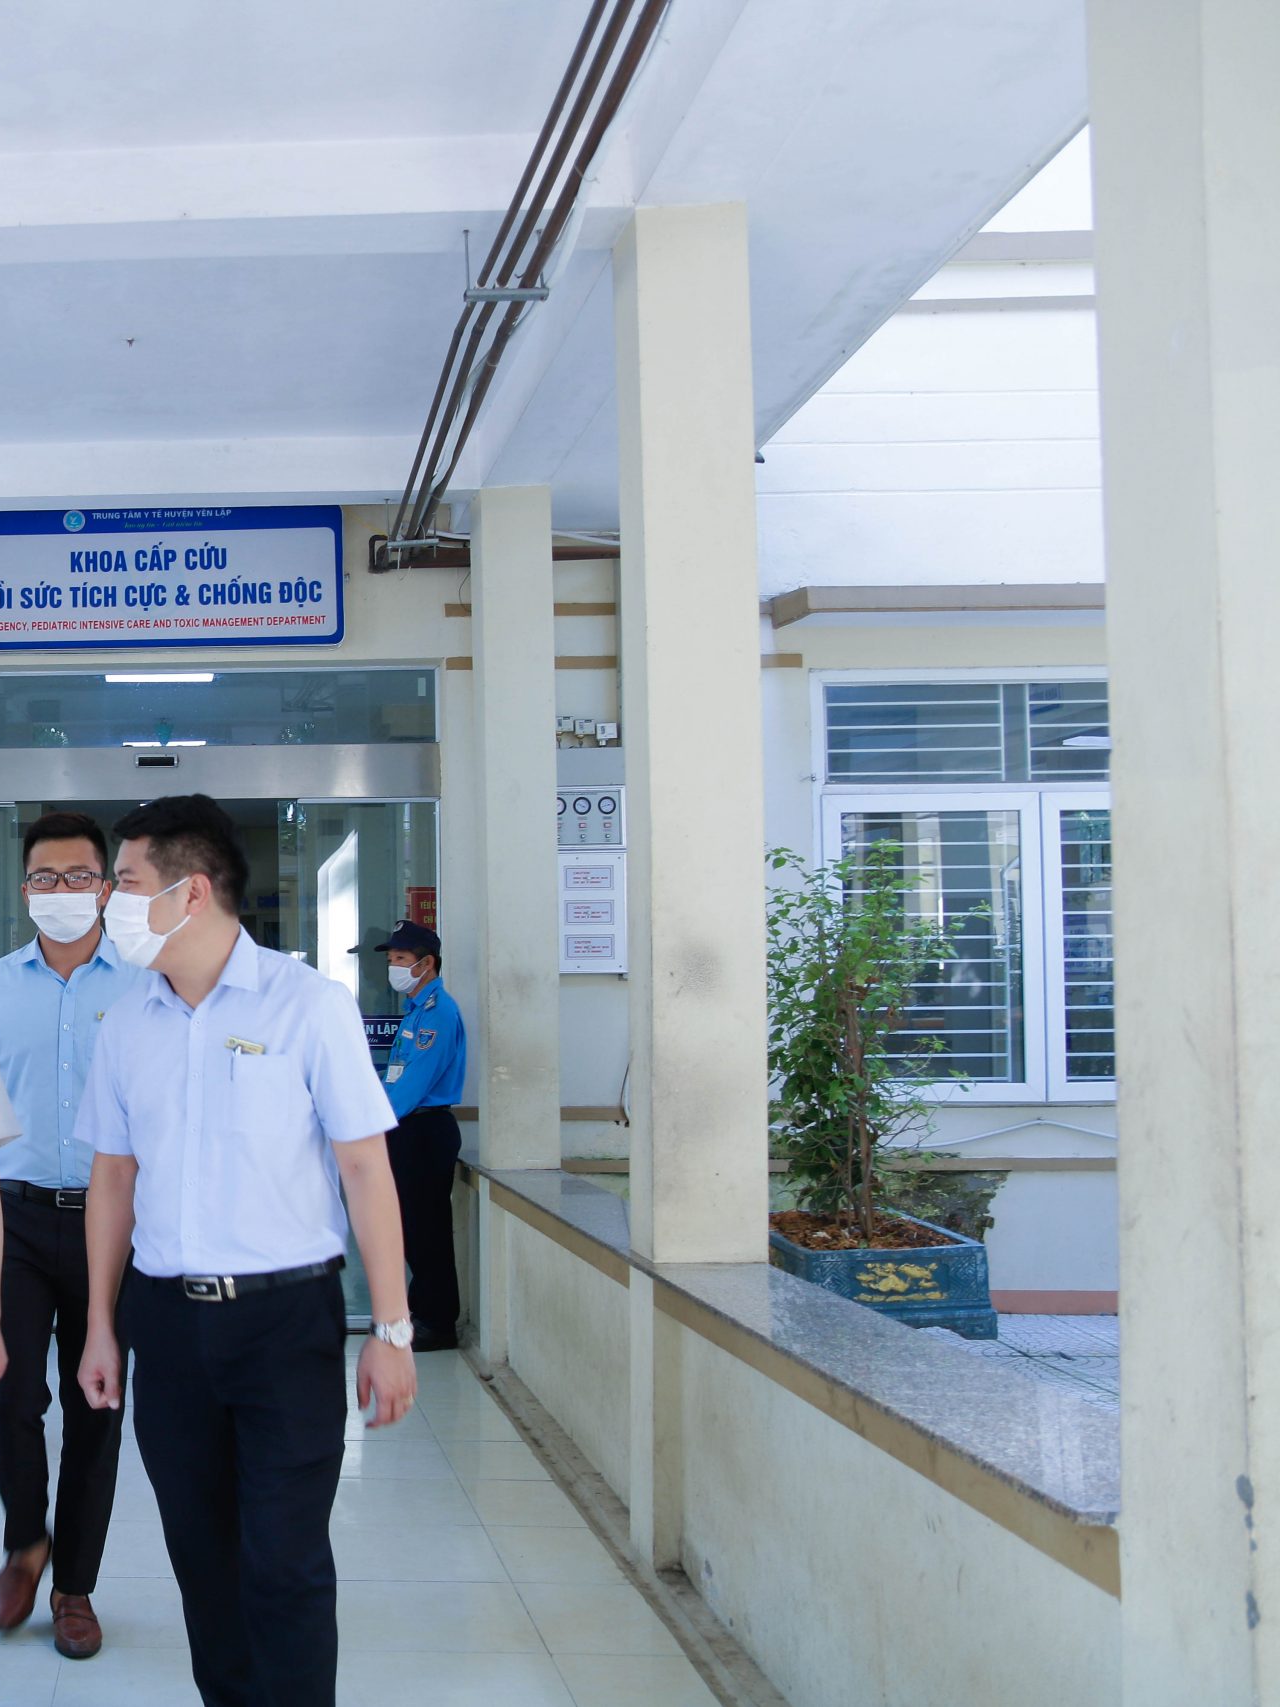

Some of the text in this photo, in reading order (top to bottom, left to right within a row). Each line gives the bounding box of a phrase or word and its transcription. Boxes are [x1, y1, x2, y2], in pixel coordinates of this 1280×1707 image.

[92, 507, 232, 520] TRUNG TÂM Y TẾ HUYỆN YÊN LẬP
[70, 542, 227, 573] KHOA CẤP CỨU
[20, 581, 62, 609] SỨC
[69, 582, 117, 608] TÍCH
[124, 583, 167, 612] CỰC
[175, 584, 191, 606] &
[198, 575, 271, 605] CHỐNG
[278, 576, 323, 608] ĐỘC
[31, 621, 77, 631] PEDIATRIC
[79, 620, 124, 630] INTENSIVE
[127, 619, 151, 629] CARE
[153, 618, 172, 628] AND
[174, 618, 200, 628] TOXIC
[202, 616, 265, 627] MANAGEMENT
[267, 615, 326, 626] DEPARTMENT
[378, 1022, 398, 1037] LẬP
